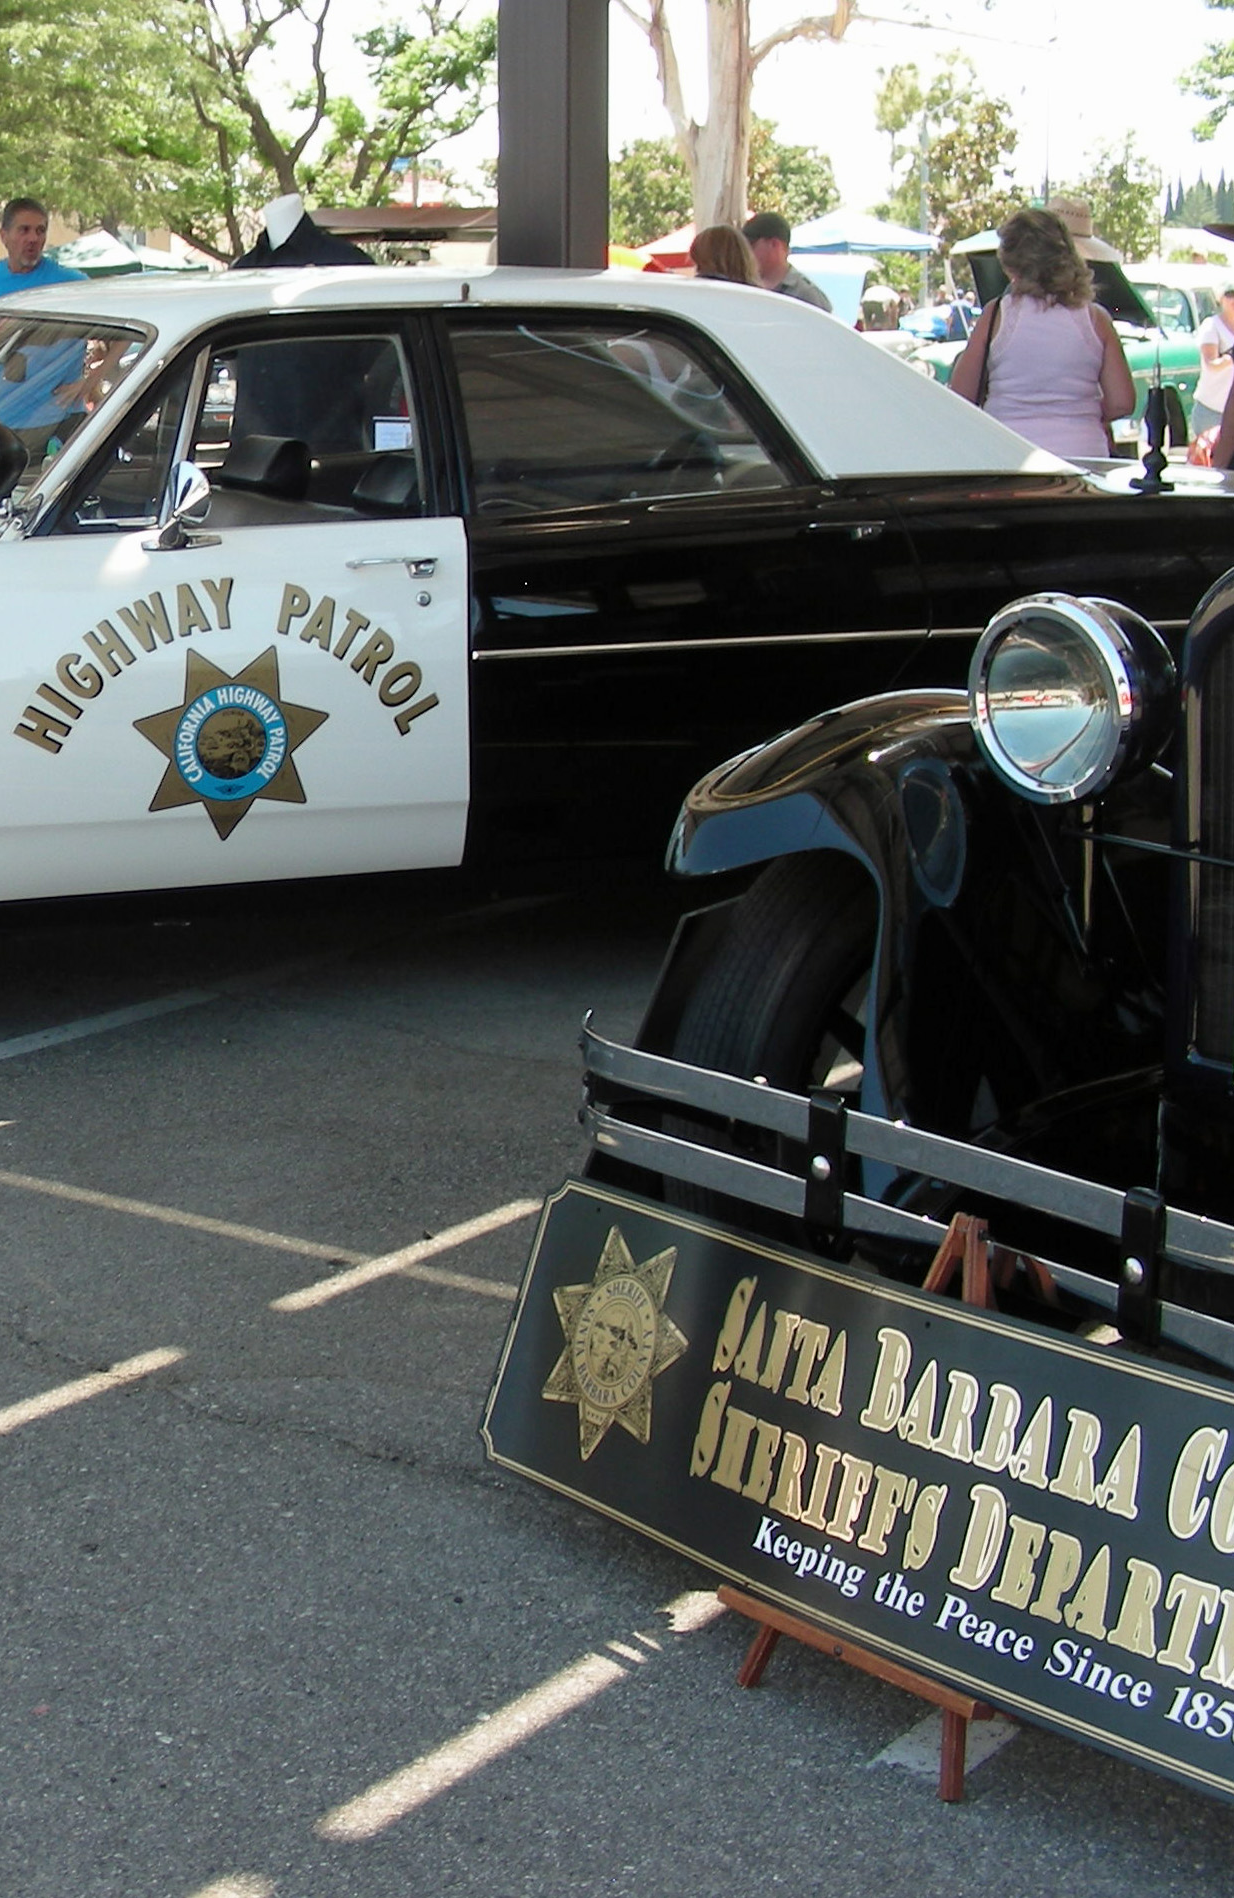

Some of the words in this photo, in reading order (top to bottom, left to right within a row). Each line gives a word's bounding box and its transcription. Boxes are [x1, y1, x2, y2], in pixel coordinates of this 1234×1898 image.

[13, 577, 234, 754] HIGHWAY
[276, 583, 440, 736] PATROL
[177, 695, 216, 784] CALIFORNIA
[216, 686, 281, 723] HIGHWAY
[256, 726, 286, 780] PATROL
[575, 1307, 596, 1357] SANTA
[606, 1280, 648, 1309] SHERIFF
[577, 1363, 618, 1404] BARBARA
[621, 1330, 654, 1397] COUNTY
[712, 1276, 848, 1417] SANTA
[860, 1327, 1142, 1520] BARBARA
[688, 1380, 949, 1570] SHERIFF'S
[752, 1515, 867, 1598] Keeping
[873, 1571, 926, 1617] the
[932, 1592, 1035, 1663] Peace
[1043, 1638, 1153, 1708] Since
[1164, 1686, 1234, 1742] 185
